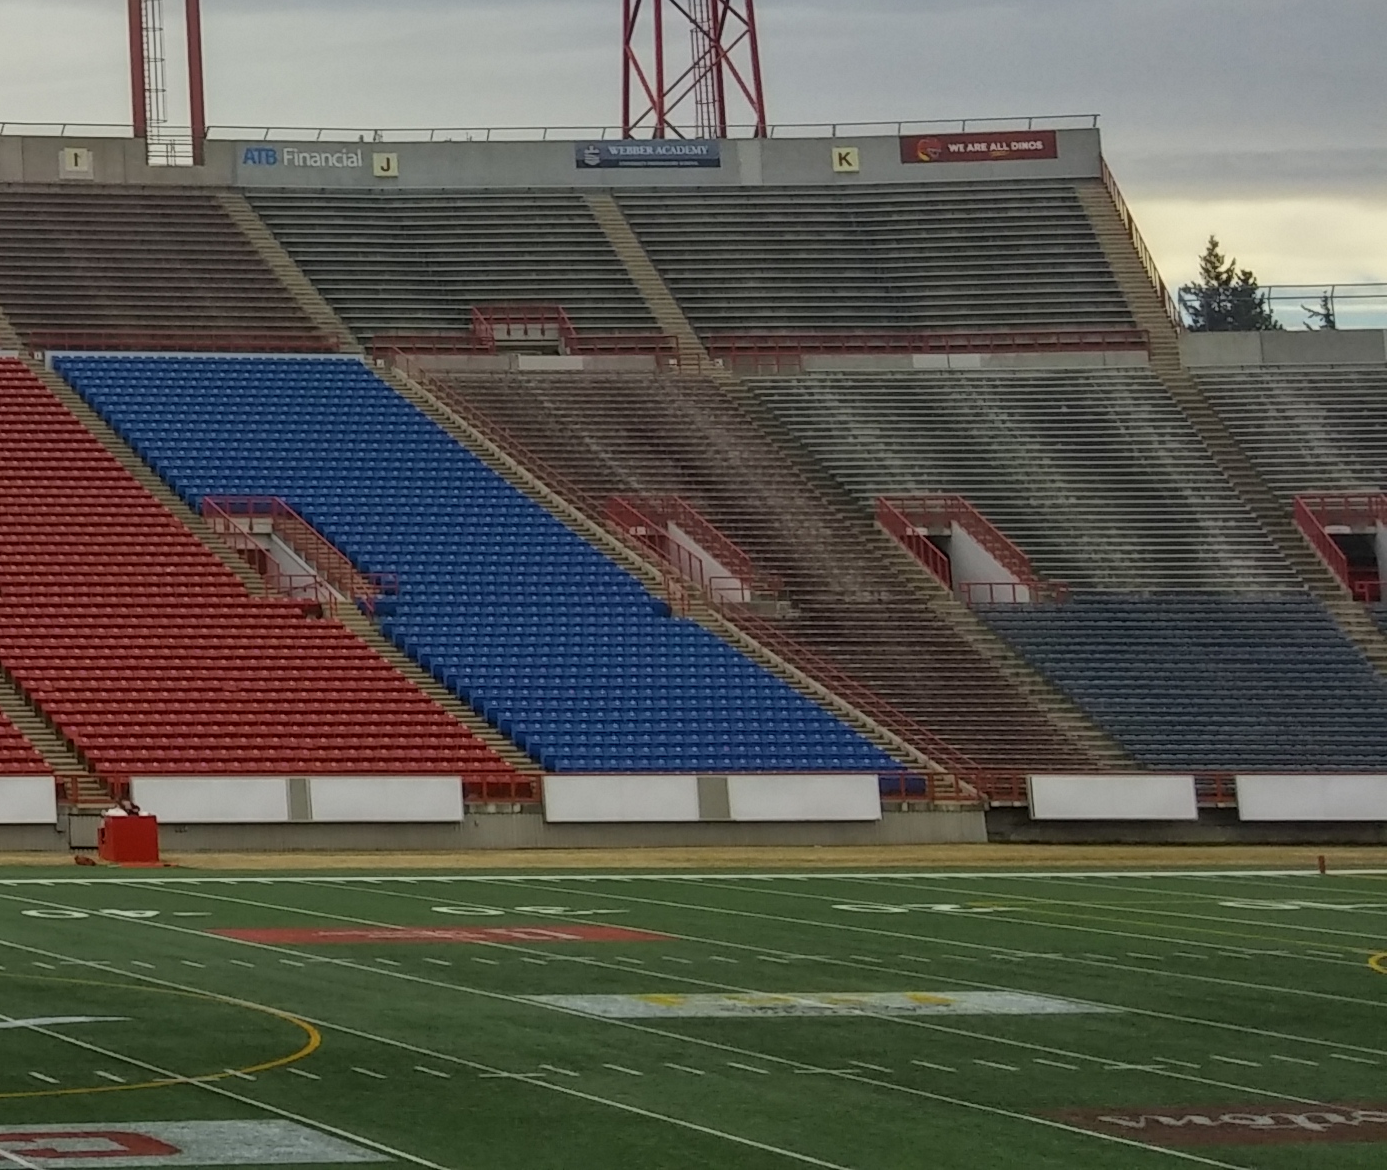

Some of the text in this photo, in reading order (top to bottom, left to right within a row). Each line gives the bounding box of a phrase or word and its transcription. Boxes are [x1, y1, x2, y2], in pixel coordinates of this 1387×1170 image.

[608, 145, 709, 155] WEBBER ACADEMY
[948, 141, 1043, 152] WE ARE ALL DINOS
[242, 148, 363, 168] ATB Financial
[381, 157, 391, 172] J
[838, 152, 853, 167] K
[1096, 1109, 1387, 1133] ortons
